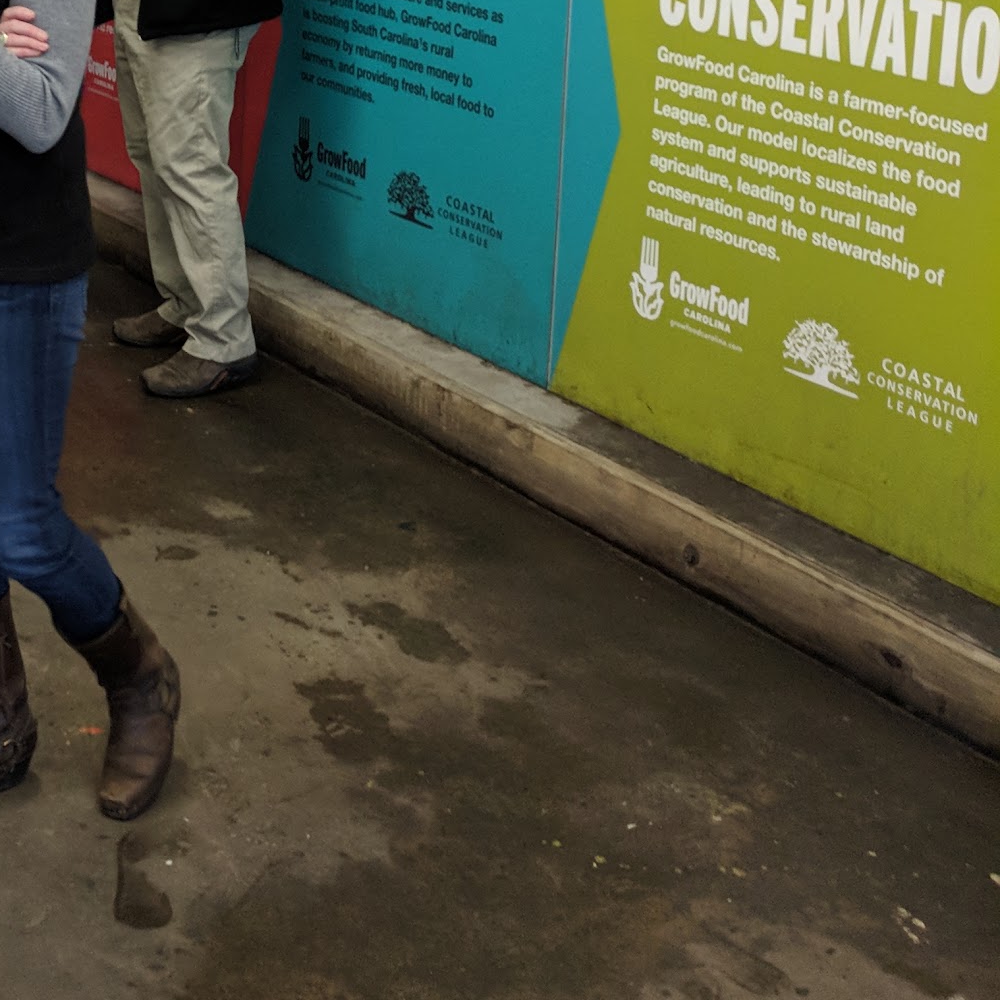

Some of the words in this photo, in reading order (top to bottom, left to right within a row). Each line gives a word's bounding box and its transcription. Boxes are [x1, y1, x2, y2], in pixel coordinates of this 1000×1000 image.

[312, 9, 349, 33] boosting
[351, 18, 378, 38] South
[380, 27, 429, 52] Carolina's
[430, 43, 454, 58] rural
[378, 3, 398, 22] hub,
[400, 9, 452, 35] GrowFood
[454, 23, 497, 47] Carolina
[446, 0, 489, 21] services
[491, 10, 504, 24] as
[302, 30, 340, 51] economy
[342, 39, 353, 55] by
[355, 44, 397, 68] returning
[399, 57, 424, 73] more
[426, 65, 460, 87] money
[462, 73, 473, 88] to
[302, 47, 336, 71] farmers,
[338, 61, 355, 76] and
[357, 67, 399, 92] providing
[401, 78, 428, 100] fresh,
[430, 86, 455, 106] local
[457, 95, 481, 114] food
[483, 102, 495, 119] to
[301, 71, 315, 83] our
[317, 76, 375, 104] communities.
[657, 45, 734, 79] GrowFood
[738, 64, 805, 96] Carolina
[809, 81, 824, 101] is
[828, 89, 839, 105] a
[843, 90, 989, 142] farmer-focused
[655, 75, 718, 105] program
[721, 88, 739, 107] of
[741, 92, 766, 115] the
[770, 101, 834, 133] Coastal
[838, 118, 961, 166] Conservation
[317, 141, 367, 180] GrowFood
[651, 126, 704, 153] system
[707, 138, 736, 163] and
[739, 151, 811, 185] supports
[816, 175, 917, 217] sustainable
[653, 98, 711, 130] League.
[715, 114, 744, 136] Our
[747, 124, 798, 152] model
[801, 137, 877, 175] localizes
[882, 159, 911, 184] the
[916, 168, 961, 199] food
[445, 195, 495, 224] COASTAL
[649, 152, 733, 192] agriculture,
[737, 176, 795, 213] leading
[799, 195, 816, 215] to
[820, 203, 860, 230] rural
[865, 215, 905, 243] land
[437, 207, 503, 241] CONSERVATION
[448, 227, 489, 249] LEAGUE
[646, 203, 697, 233] natural
[699, 225, 781, 261] resources.
[648, 179, 743, 221] conservation
[747, 207, 777, 232] and
[781, 216, 807, 241] the
[811, 228, 920, 281] stewardship
[925, 267, 946, 288] of
[670, 270, 749, 326] GrowFood
[683, 307, 731, 334] CAROLINA
[867, 371, 978, 426] CONSERVATION
[881, 357, 965, 402] COASTAL
[887, 395, 953, 433] LEAGUE
